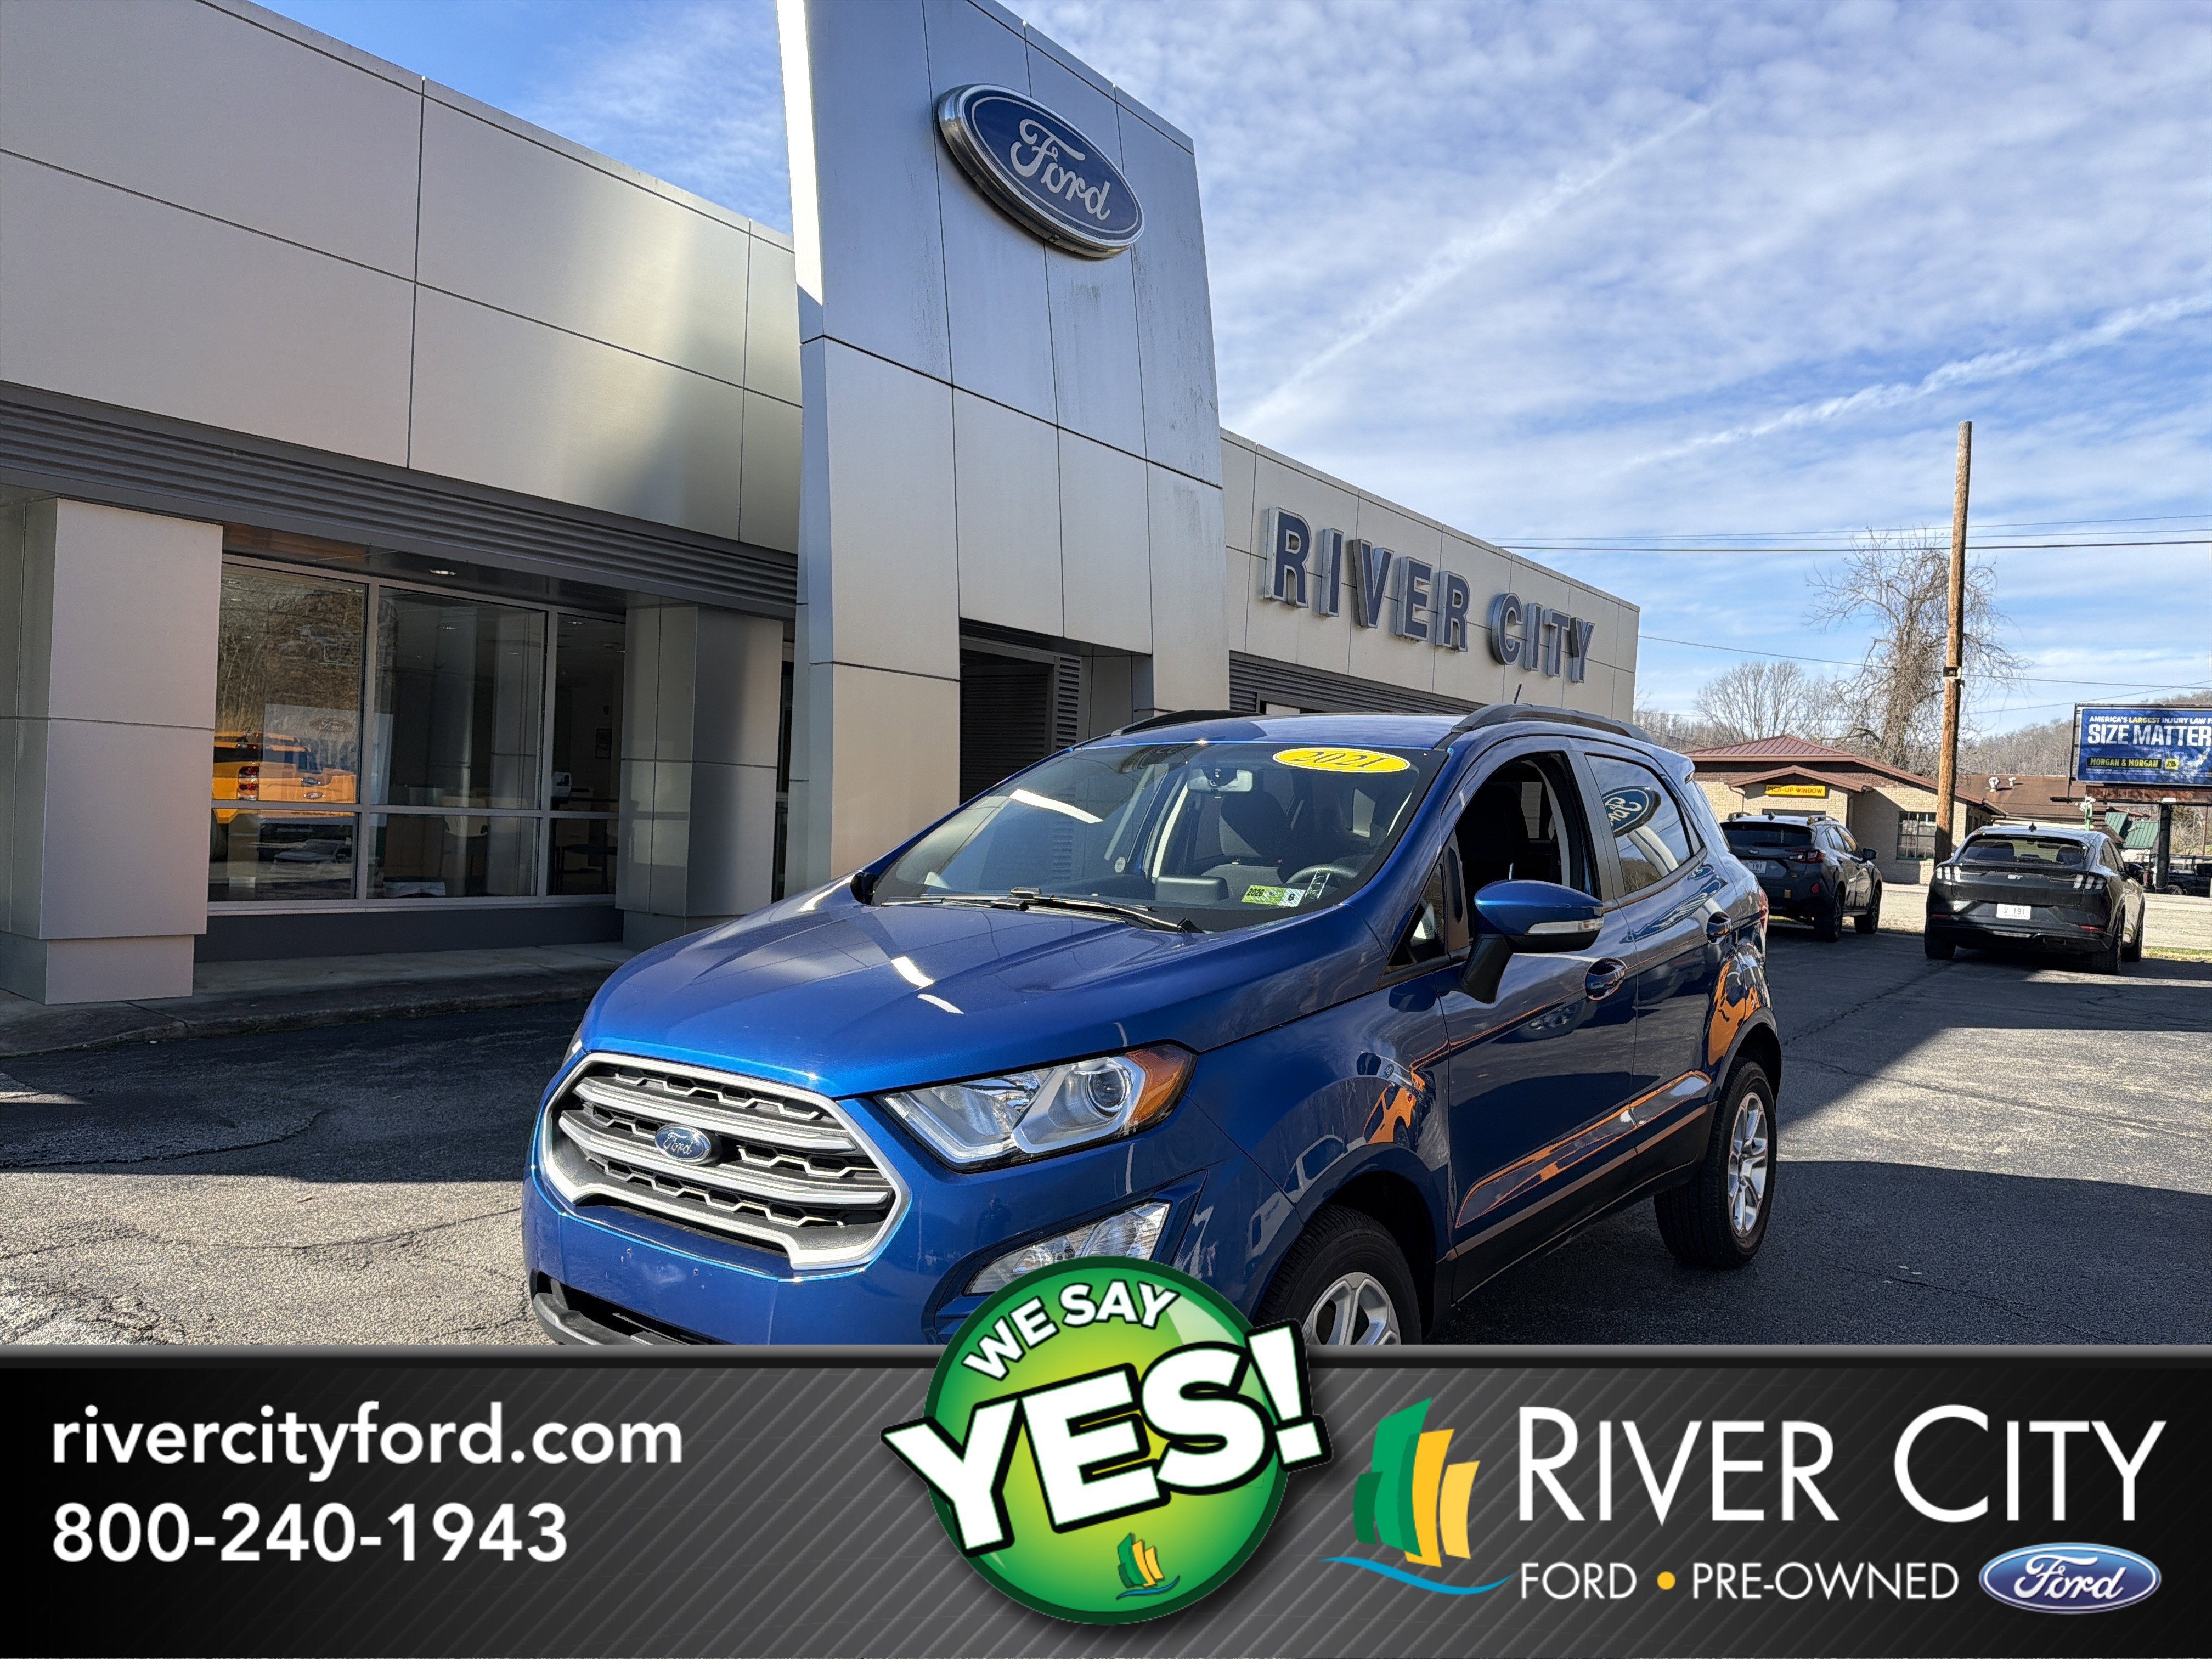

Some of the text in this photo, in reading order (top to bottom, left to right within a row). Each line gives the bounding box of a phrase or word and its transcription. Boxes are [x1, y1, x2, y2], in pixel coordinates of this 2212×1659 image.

[1010, 118, 1111, 221] Ford
[1264, 506, 1595, 684] RIVER CITY
[2087, 724, 2212, 747] SIZE MATTER
[1291, 751, 1388, 768] 2021
[2090, 758, 2119, 766] MORGAN
[2128, 759, 2158, 768] MORGAN
[663, 1132, 693, 1155] Ford
